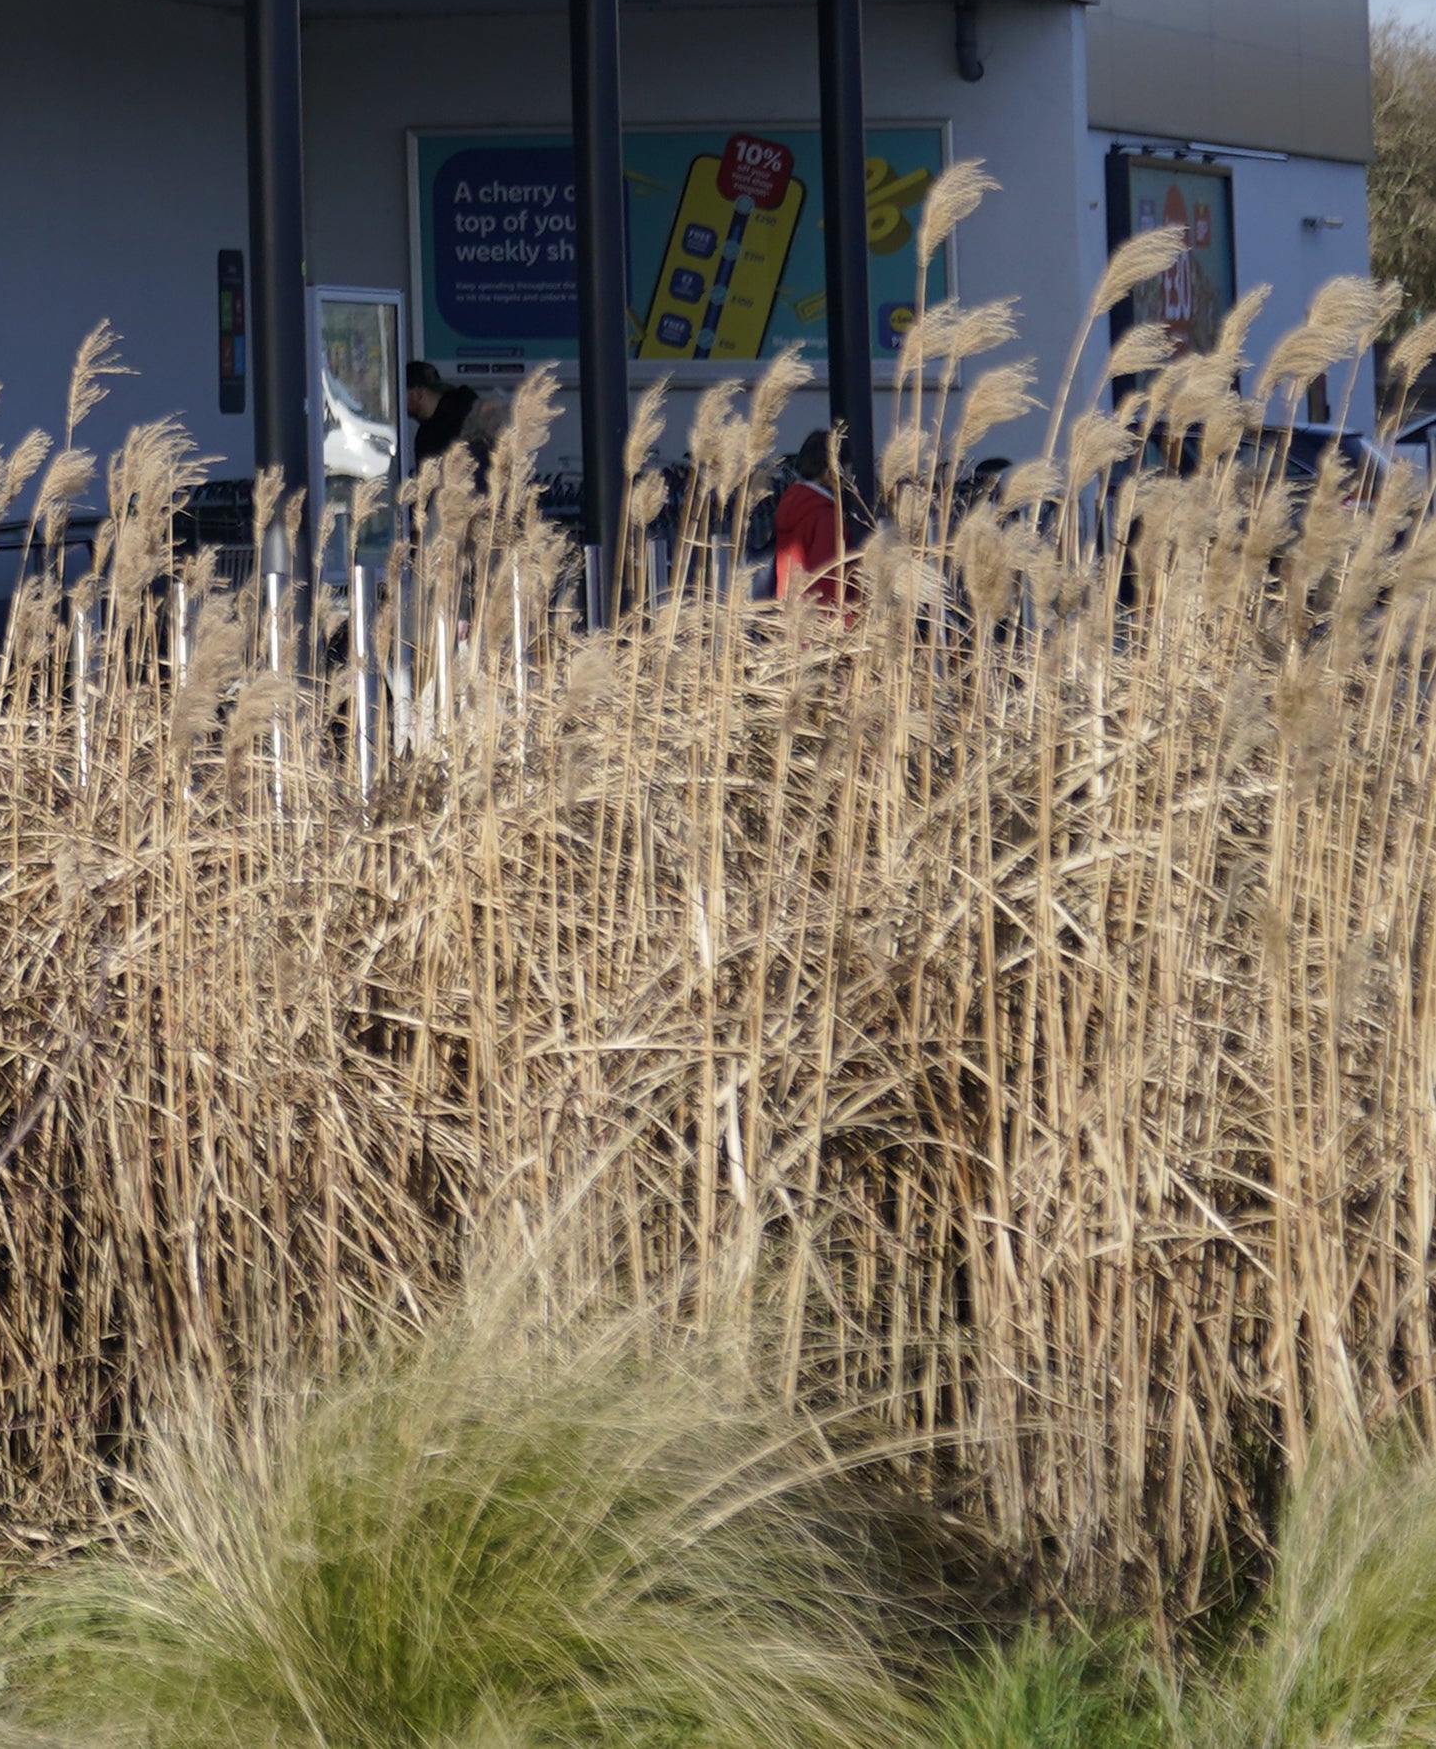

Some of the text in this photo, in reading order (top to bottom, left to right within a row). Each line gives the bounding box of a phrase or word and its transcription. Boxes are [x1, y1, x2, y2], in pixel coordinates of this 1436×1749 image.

[736, 140, 782, 172] 10%
[454, 180, 472, 202] A
[478, 179, 557, 208] cherry
[454, 210, 576, 238] top of you
[454, 238, 575, 266] weekly sh
